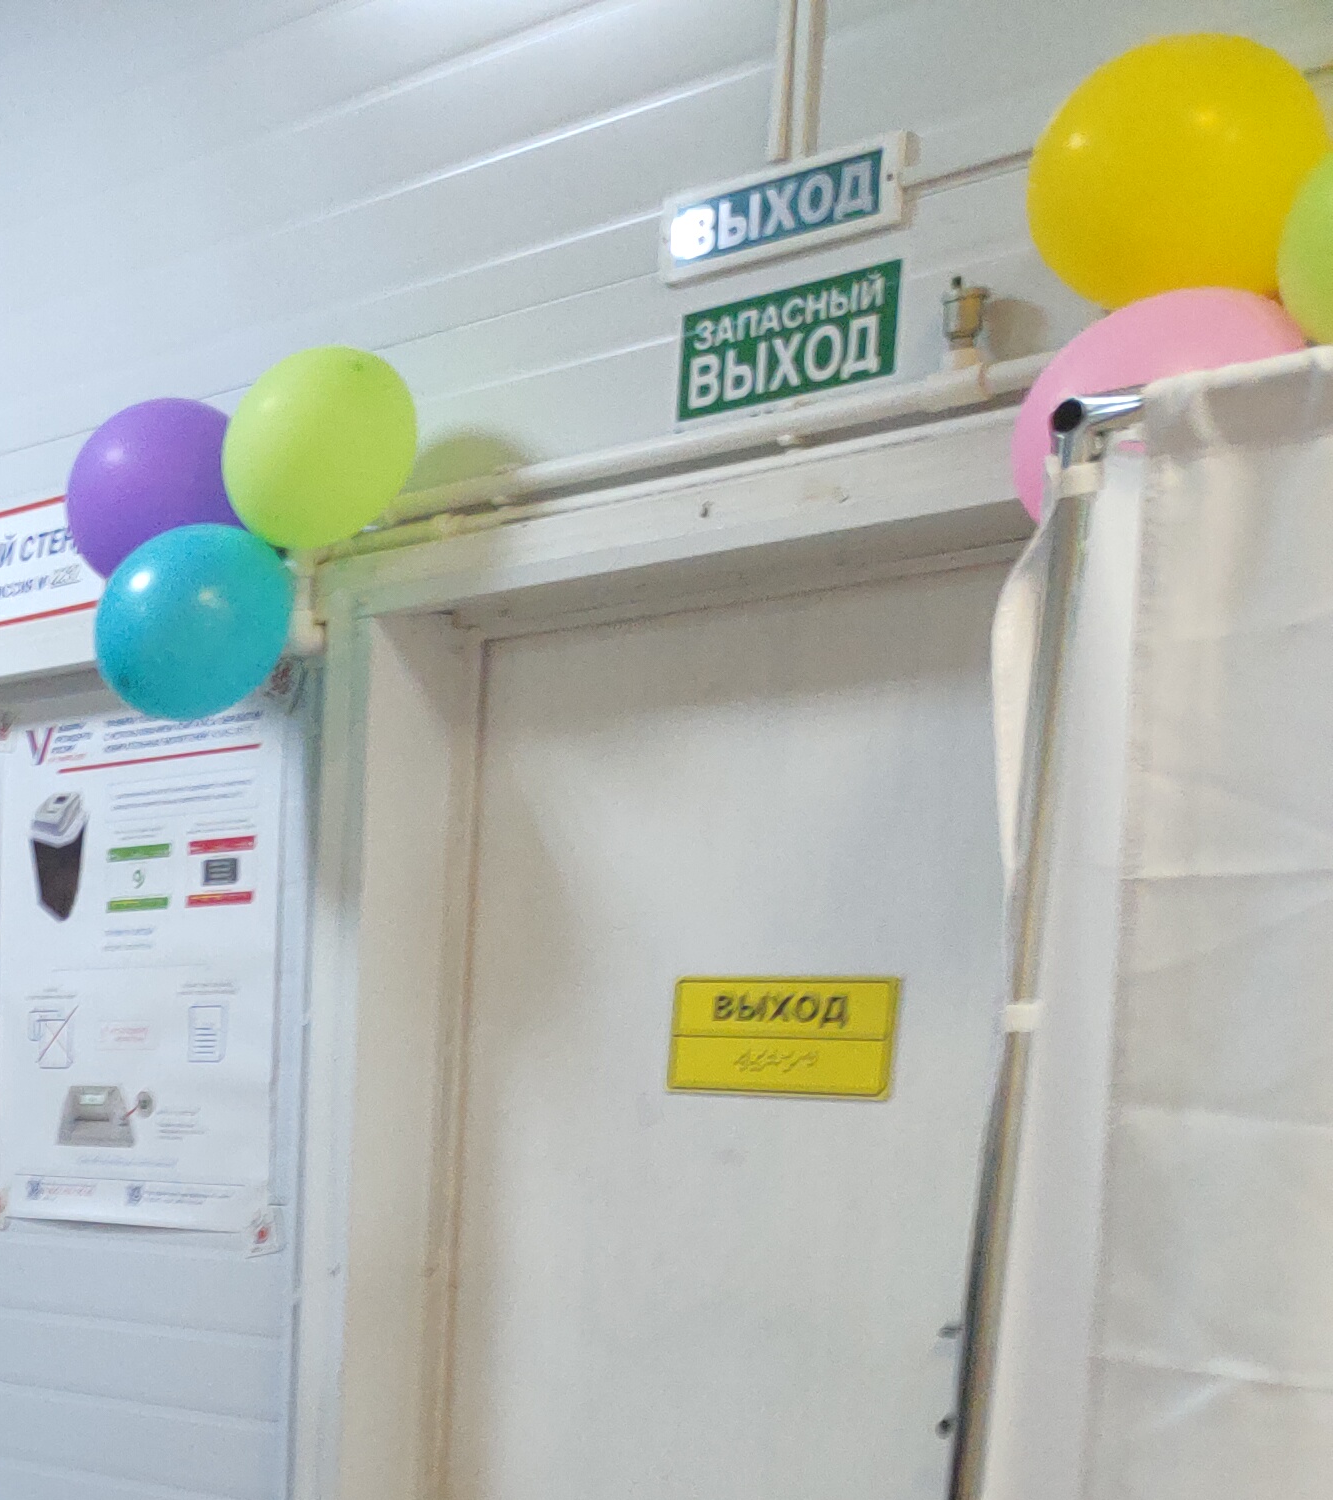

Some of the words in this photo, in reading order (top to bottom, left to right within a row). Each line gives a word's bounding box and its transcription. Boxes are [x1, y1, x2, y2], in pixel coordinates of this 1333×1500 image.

[671, 160, 873, 260] ВЫХОД
[693, 273, 885, 350] ЗАПАСНЫЙ
[687, 314, 881, 409] ВЫХОД
[19, 527, 79, 562] СТЕН
[711, 993, 849, 1030] ВЫХОД
